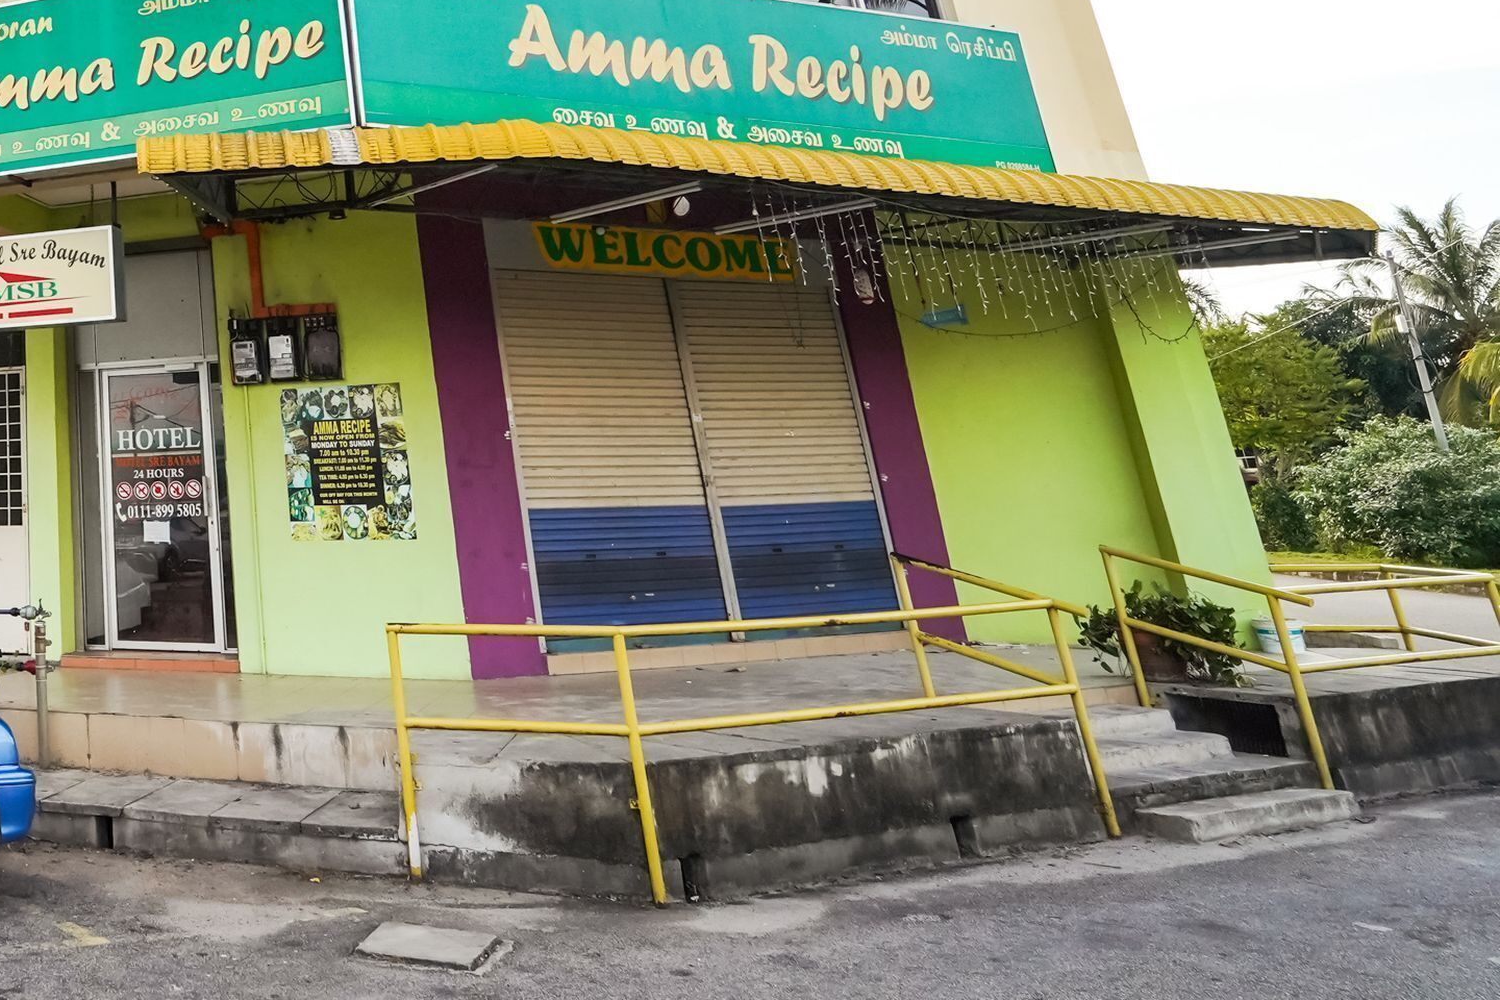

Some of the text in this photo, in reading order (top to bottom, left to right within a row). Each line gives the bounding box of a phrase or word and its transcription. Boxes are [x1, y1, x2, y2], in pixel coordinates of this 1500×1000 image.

[136, 18, 325, 87] Recipe
[880, 24, 1017, 62] அம்மா ரெசிப்பி
[508, 4, 934, 122] Amma Recipe
[12, 131, 91, 154] உணவு
[101, 121, 121, 141] &
[133, 111, 219, 136] அசைவ
[230, 96, 322, 122] உணவு
[552, 106, 615, 129] சைவ
[716, 116, 737, 140] &
[747, 124, 823, 148] அசைவ
[9, 242, 36, 263] Sre
[41, 239, 106, 268] Bayam
[537, 225, 793, 275] WELCOME
[116, 426, 201, 451] HOTEL
[313, 419, 371, 435] AMMA RECIPE
[311, 441, 338, 449] MONDAY
[133, 468, 185, 479] 24 HOURS
[167, 455, 202, 466] BAYAM
[127, 503, 202, 519] 0111-899 5805
